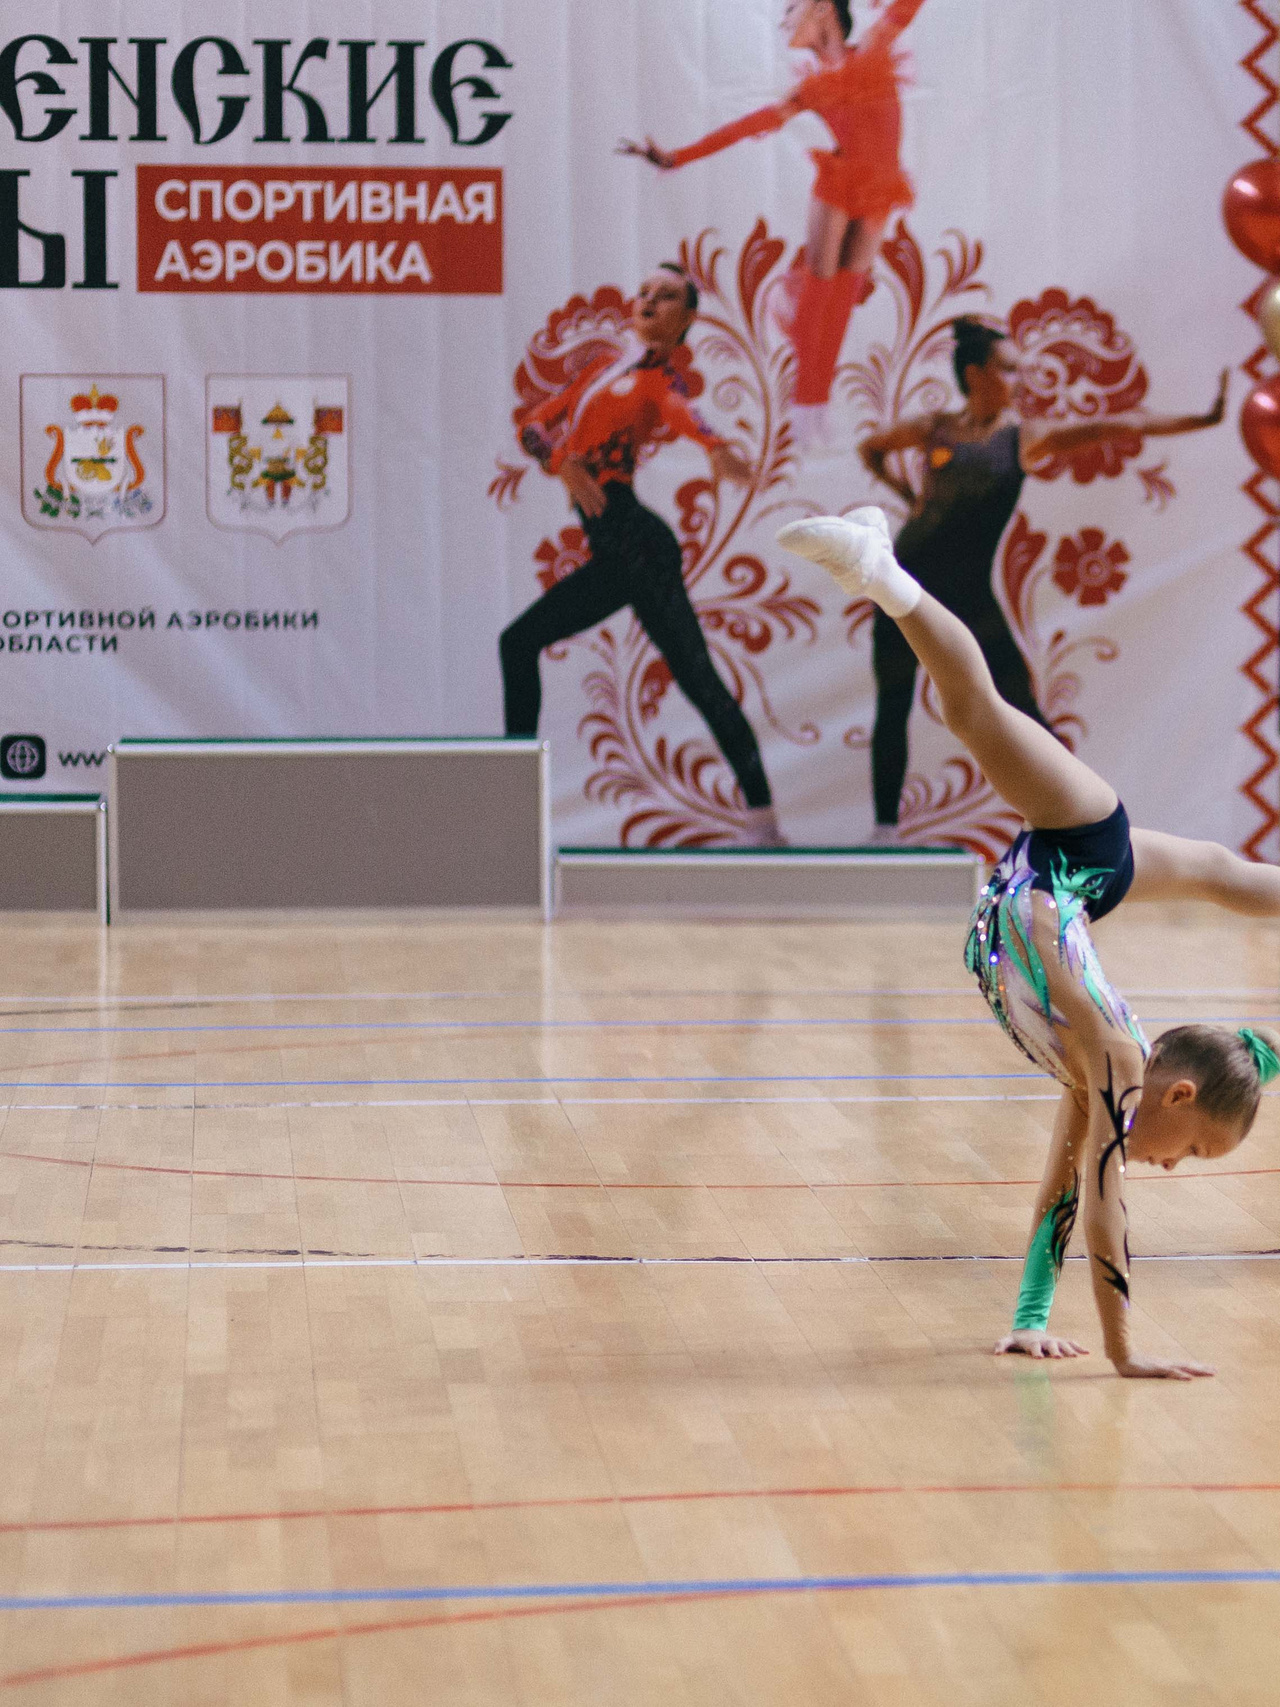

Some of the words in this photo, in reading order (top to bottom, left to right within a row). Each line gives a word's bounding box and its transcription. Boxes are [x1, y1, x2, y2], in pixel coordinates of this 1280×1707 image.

[154, 179, 497, 224] СПОРТИВНАЯ
[153, 239, 433, 284] АЭРОБИКА
[2, 606, 156, 630] ОРТИВНОЙ
[166, 609, 319, 631] АЭРОБИКИ
